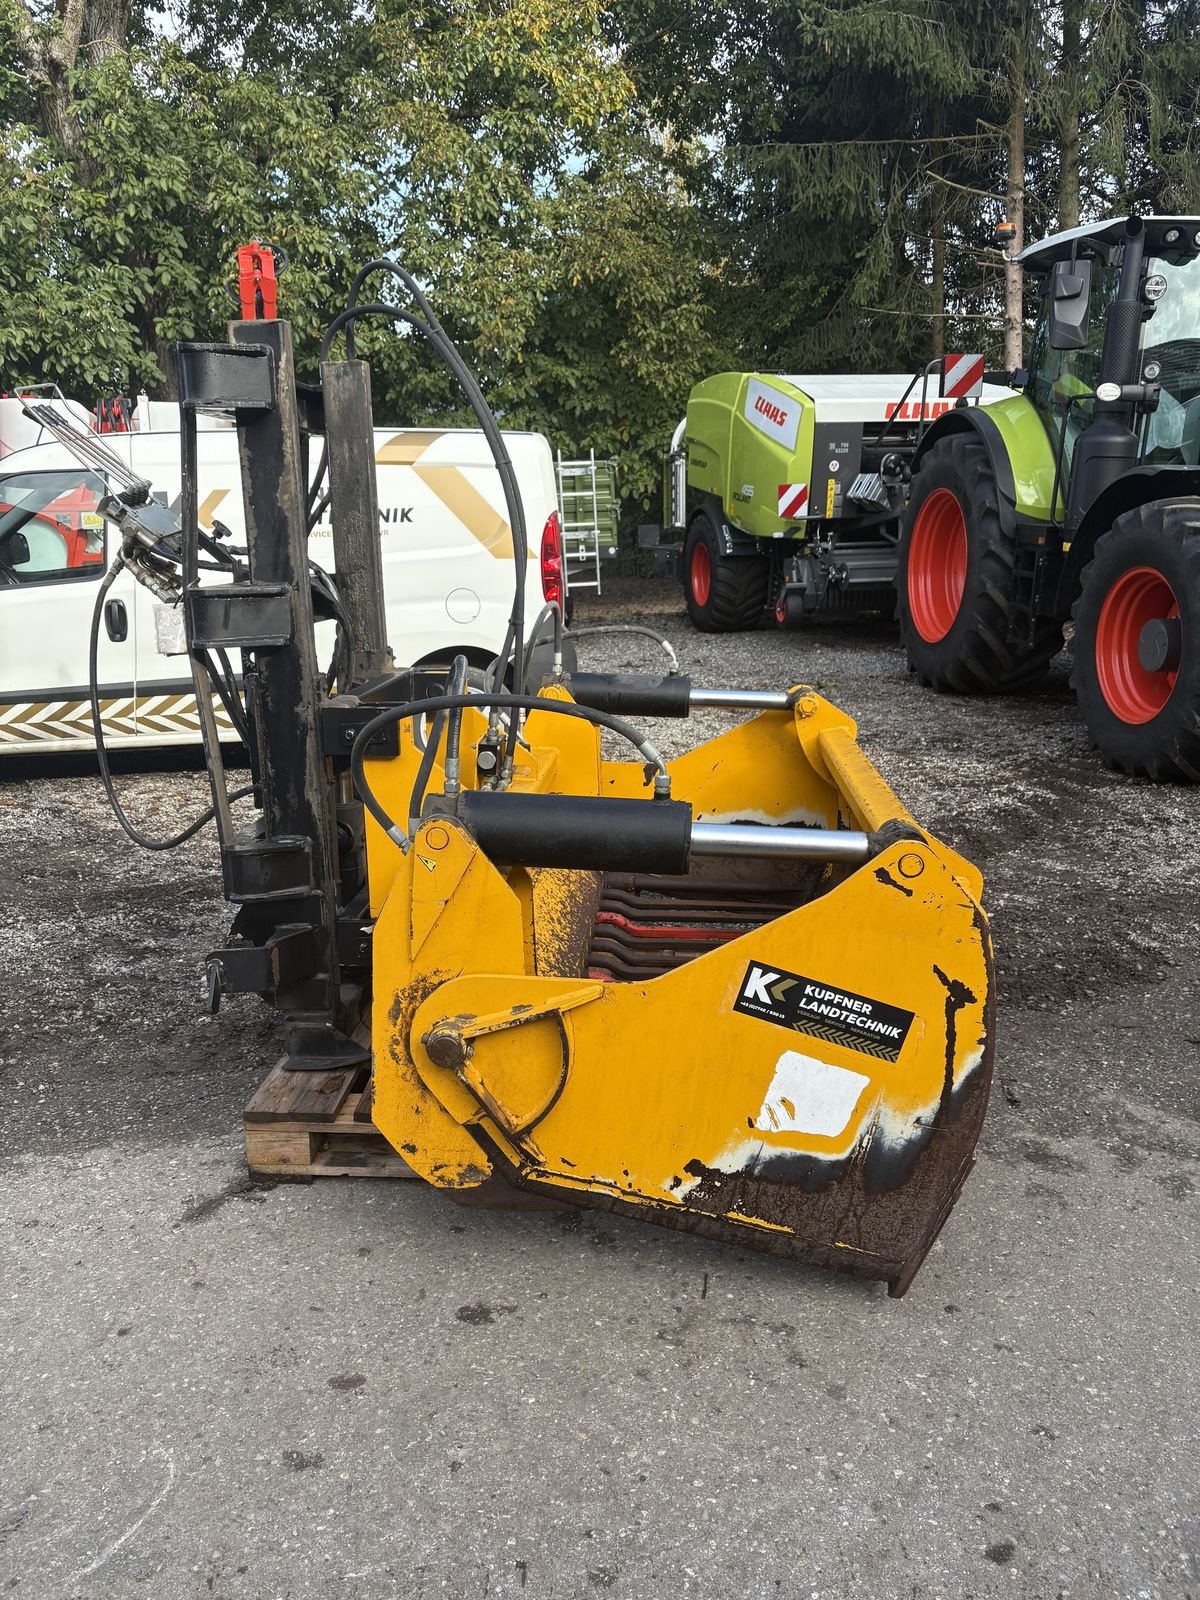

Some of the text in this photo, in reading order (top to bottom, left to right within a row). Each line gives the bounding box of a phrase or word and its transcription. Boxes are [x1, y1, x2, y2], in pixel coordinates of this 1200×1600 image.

[754, 395, 788, 427] CLAAS
[885, 402, 957, 419] CLAA
[804, 984, 873, 1016] KUPFNER
[796, 1009, 881, 1041] VERKAUF SERVICE REPARATUR
[798, 997, 903, 1039] LANDTECHNIK
